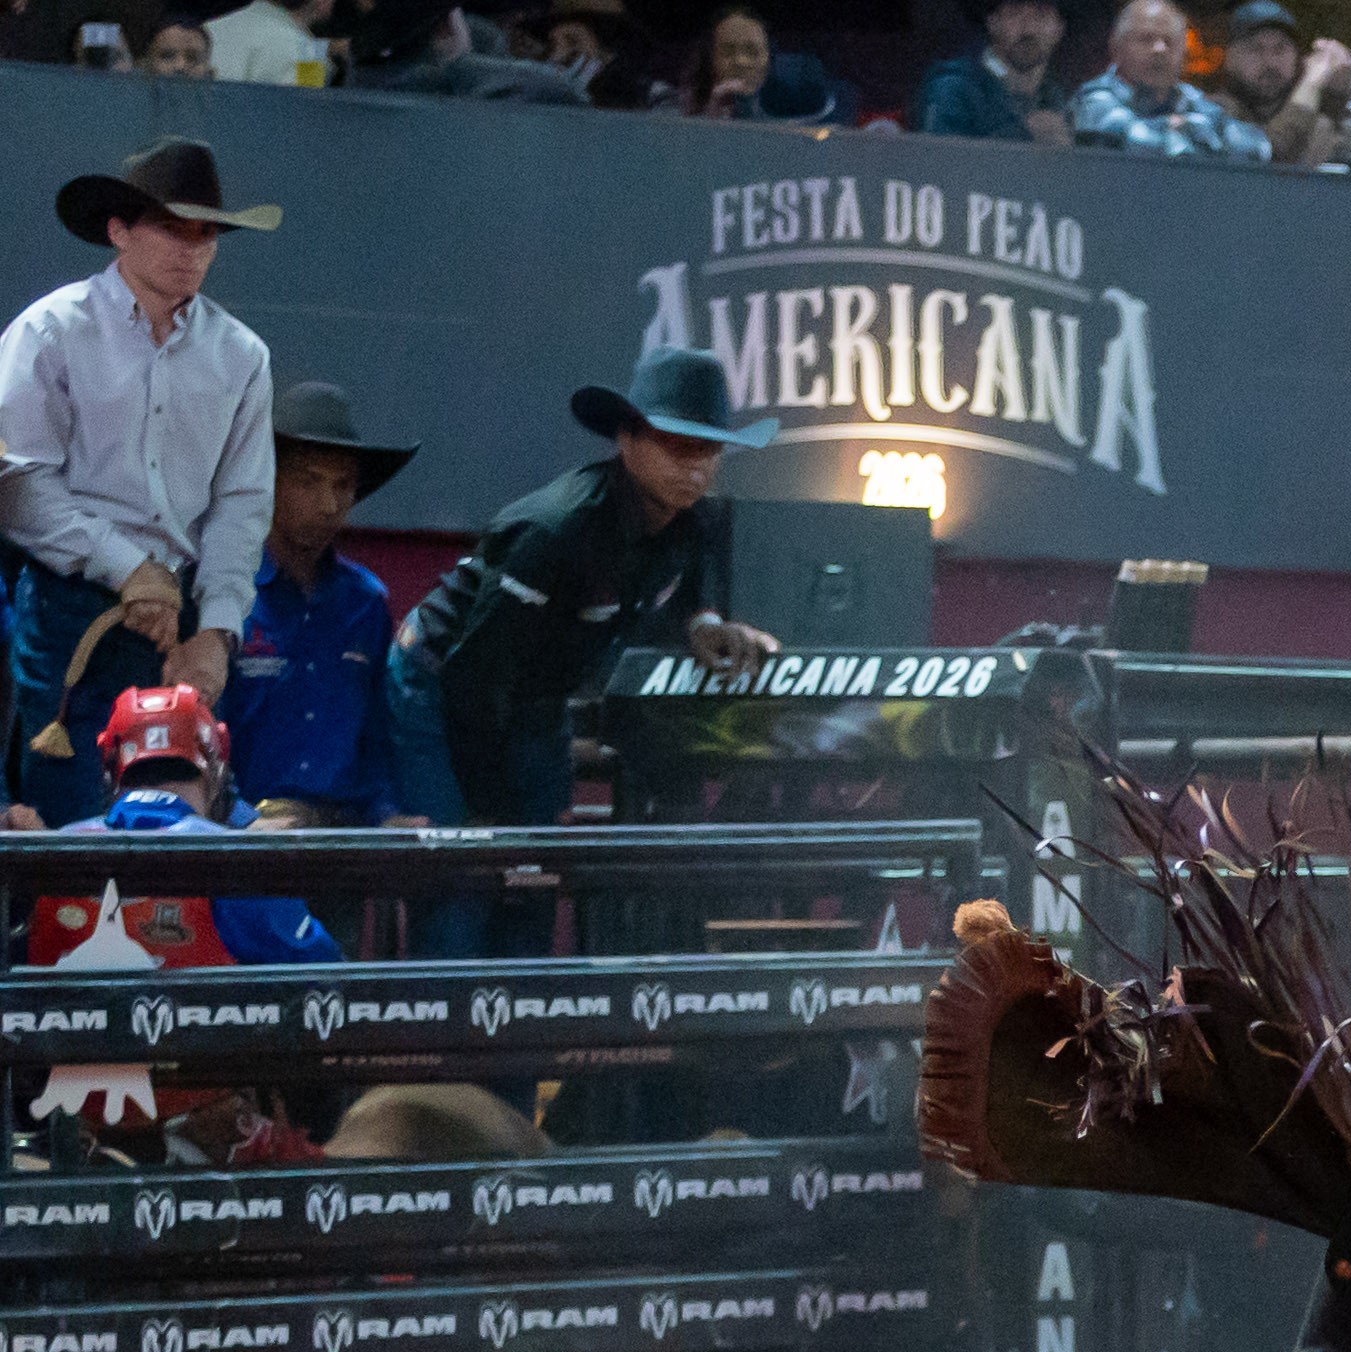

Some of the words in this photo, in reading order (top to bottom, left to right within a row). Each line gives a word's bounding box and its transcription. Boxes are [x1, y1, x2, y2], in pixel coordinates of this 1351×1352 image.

[712, 176, 863, 254] FESTA
[884, 180, 944, 247] DO
[638, 260, 1168, 496] AMERICANA
[884, 656, 998, 697] 2026
[2, 1009, 107, 1033] RAM
[177, 1004, 281, 1027] RAM
[347, 1001, 449, 1023] RAM
[513, 996, 611, 1019] RAM
[674, 991, 769, 1013] RAM
[830, 984, 923, 1006] RAM
[4, 1203, 110, 1226] RAM
[180, 1198, 283, 1221] RAM
[350, 1191, 451, 1215] RAM
[515, 1183, 613, 1207] RAM
[676, 1177, 770, 1200] RAM
[831, 1172, 923, 1193] RAM
[187, 1323, 290, 1349] RAM
[357, 1314, 457, 1340] RAM
[522, 1306, 618, 1330] RAM
[681, 1299, 774, 1322] RAM
[836, 1290, 928, 1312] RAM
